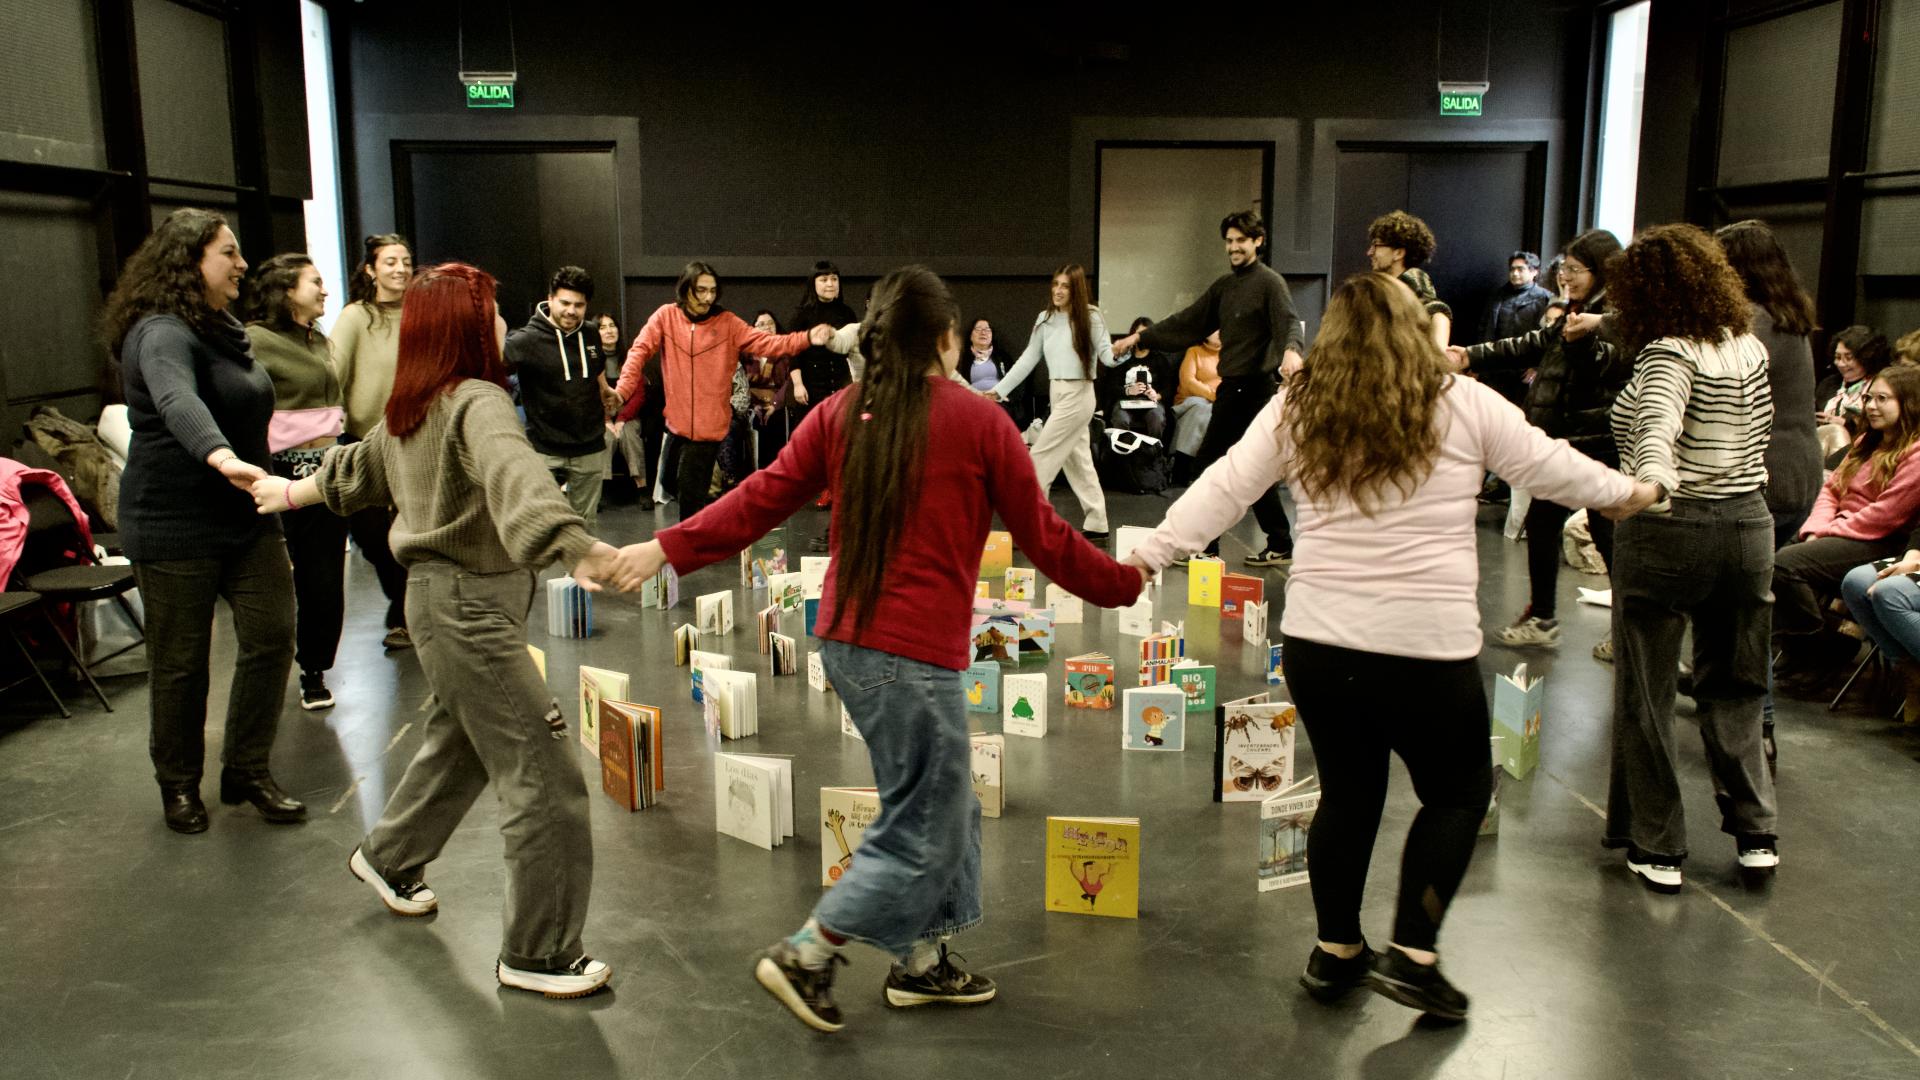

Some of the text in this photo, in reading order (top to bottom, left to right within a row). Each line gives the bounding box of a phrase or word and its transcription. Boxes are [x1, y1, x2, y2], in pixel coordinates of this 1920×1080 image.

[469, 85, 510, 99] SALIDA
[1443, 97, 1479, 110] SALIDA
[1182, 674, 1201, 683] BIO
[1289, 801, 1304, 811] VIVEN
